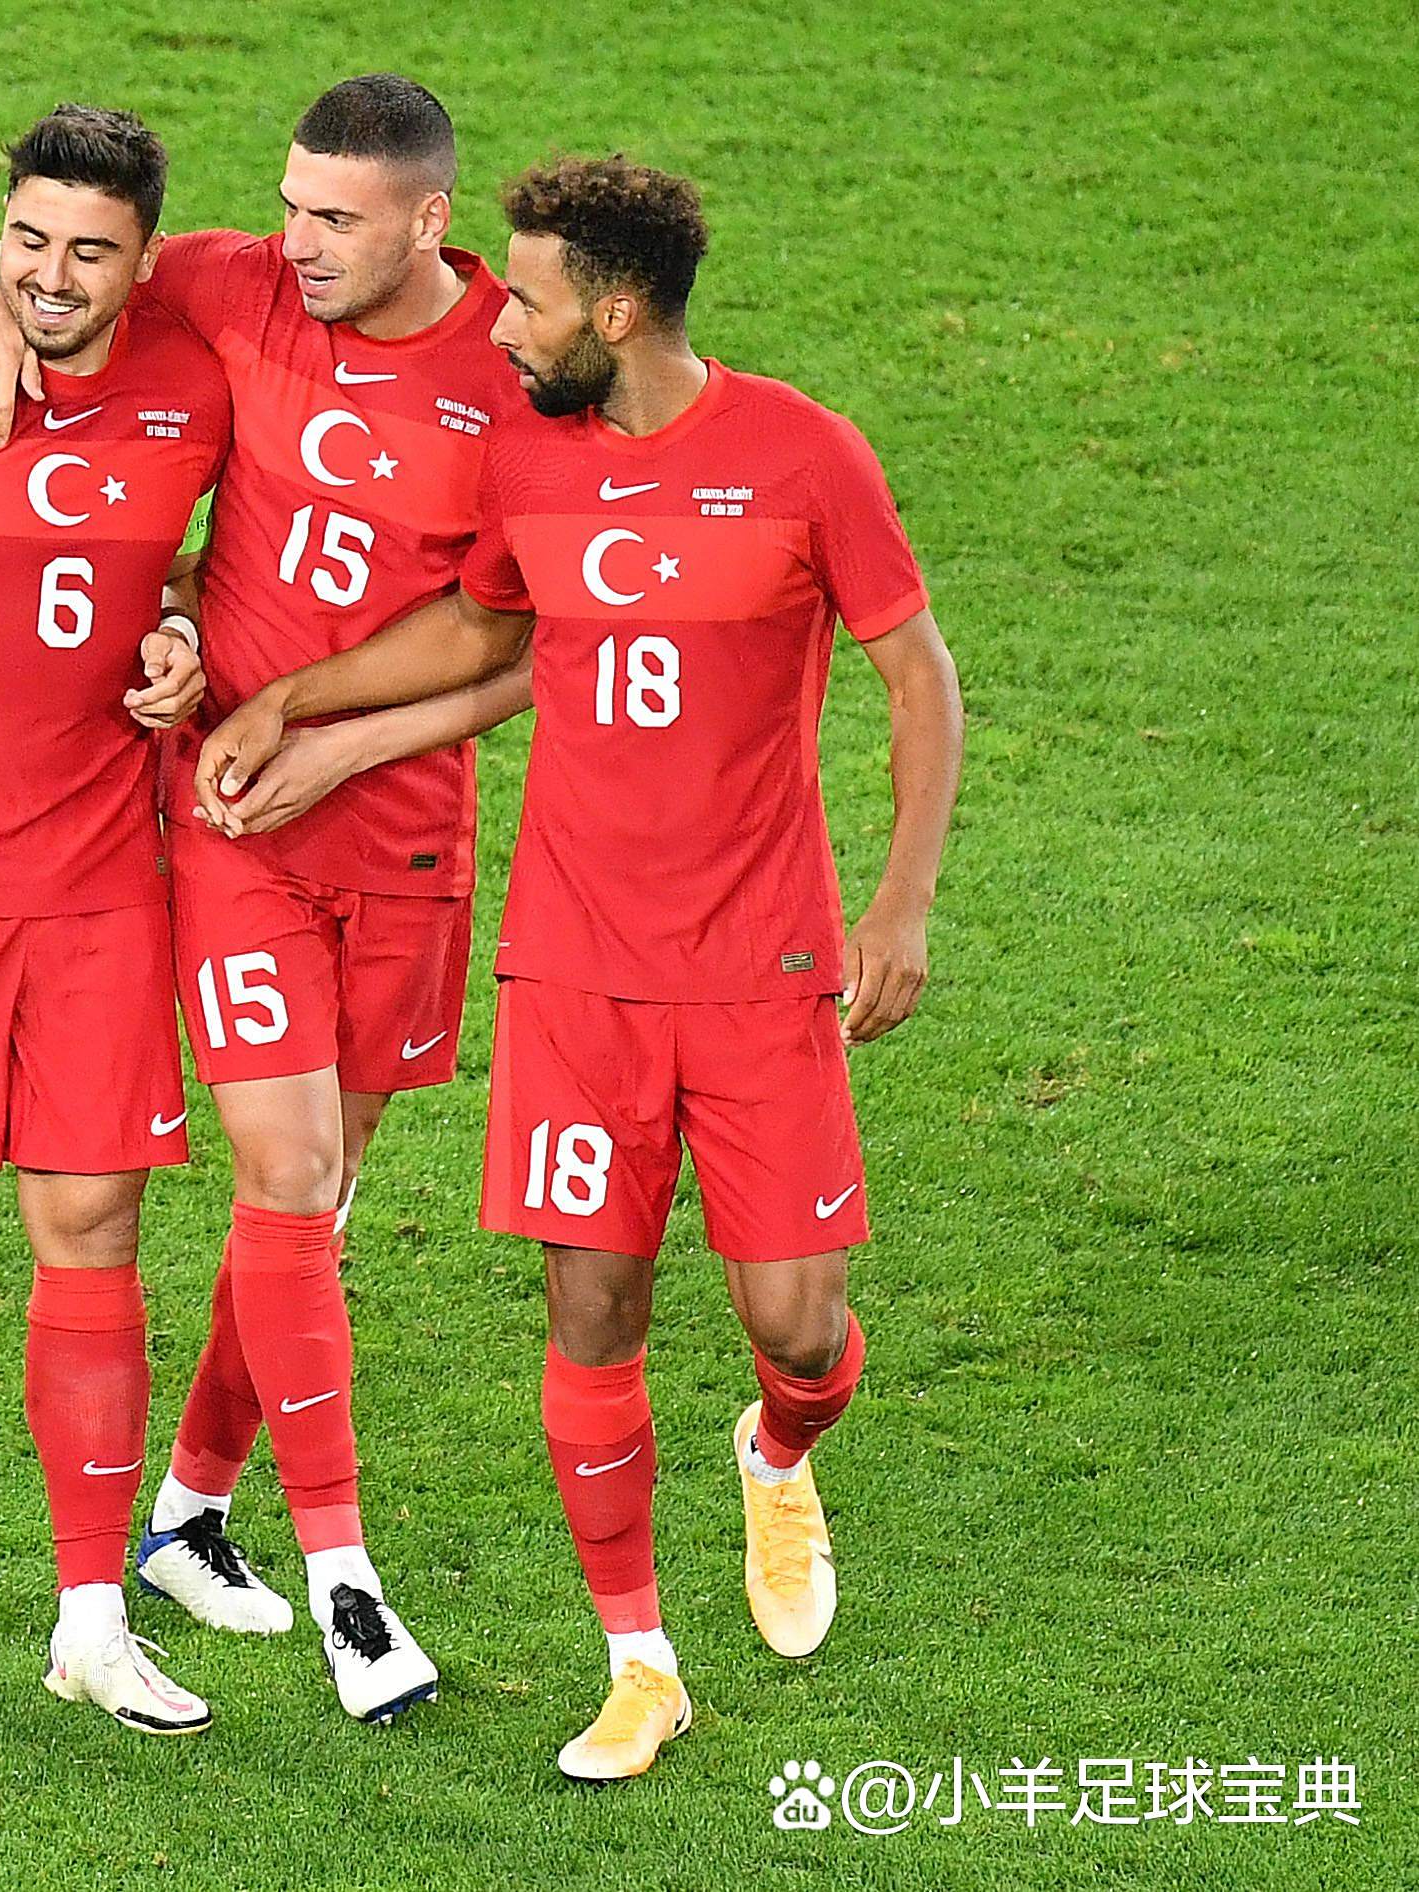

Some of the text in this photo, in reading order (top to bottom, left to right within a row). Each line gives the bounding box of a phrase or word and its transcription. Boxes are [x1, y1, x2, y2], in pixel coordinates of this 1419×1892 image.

[37, 557, 93, 648] 6
[279, 505, 375, 607] 15
[596, 635, 680, 727] 18
[197, 951, 290, 1049] 15
[524, 1119, 614, 1216] 18
